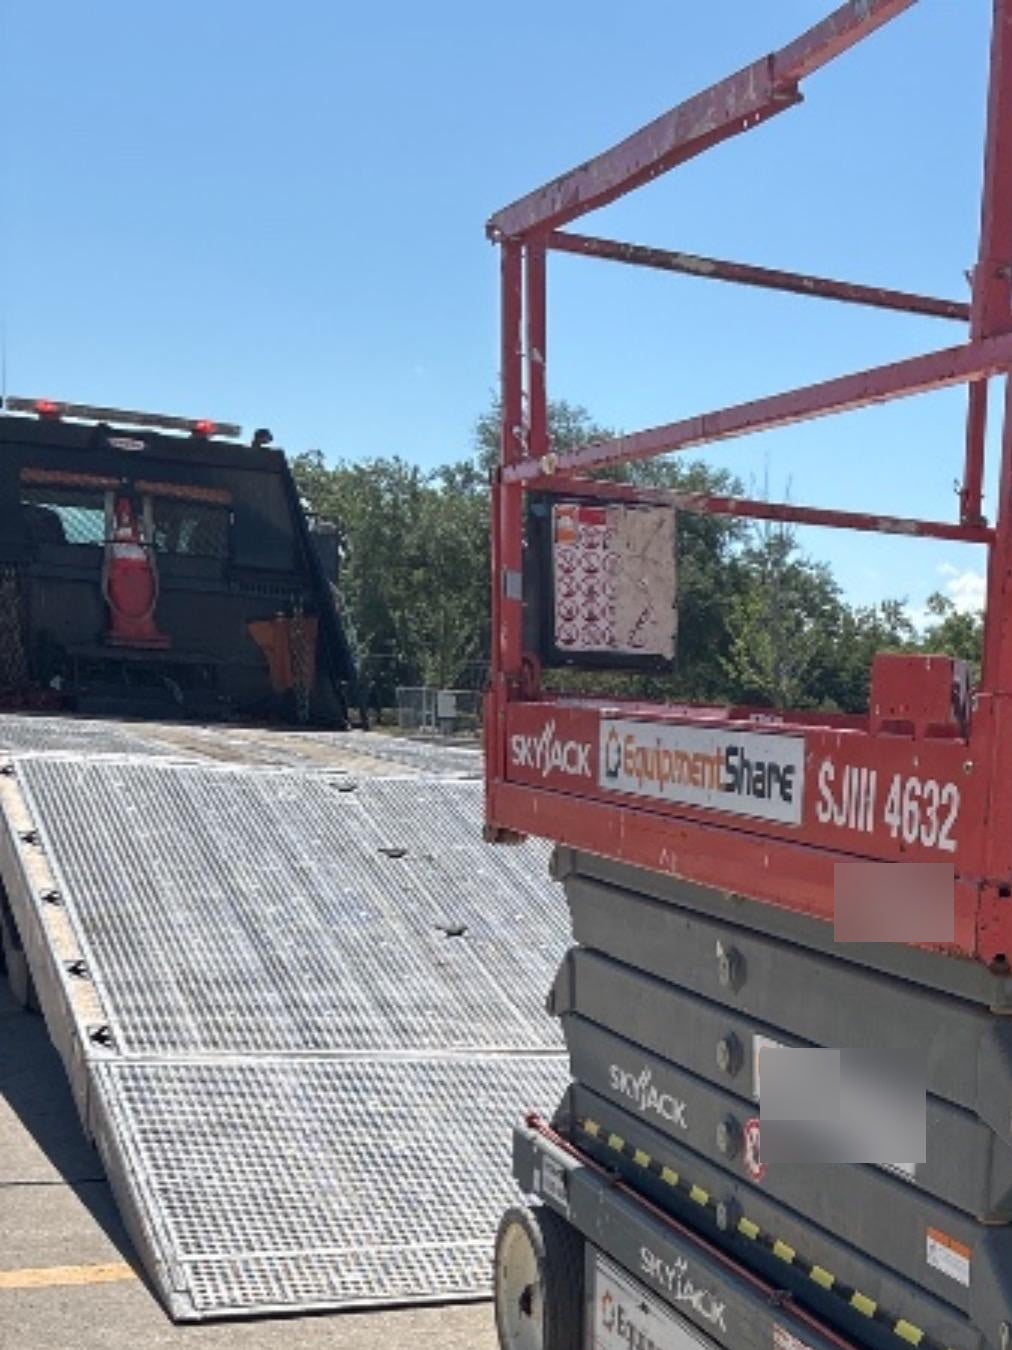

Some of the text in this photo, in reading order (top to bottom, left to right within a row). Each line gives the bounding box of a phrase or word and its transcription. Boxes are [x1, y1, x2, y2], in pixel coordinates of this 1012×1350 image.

[511, 720, 591, 777] SKYJACK
[623, 736, 795, 803] EquipmentShare
[884, 774, 960, 852] 4632
[609, 1064, 687, 1129] SKYJACK
[640, 1247, 727, 1332] SKYJACK
